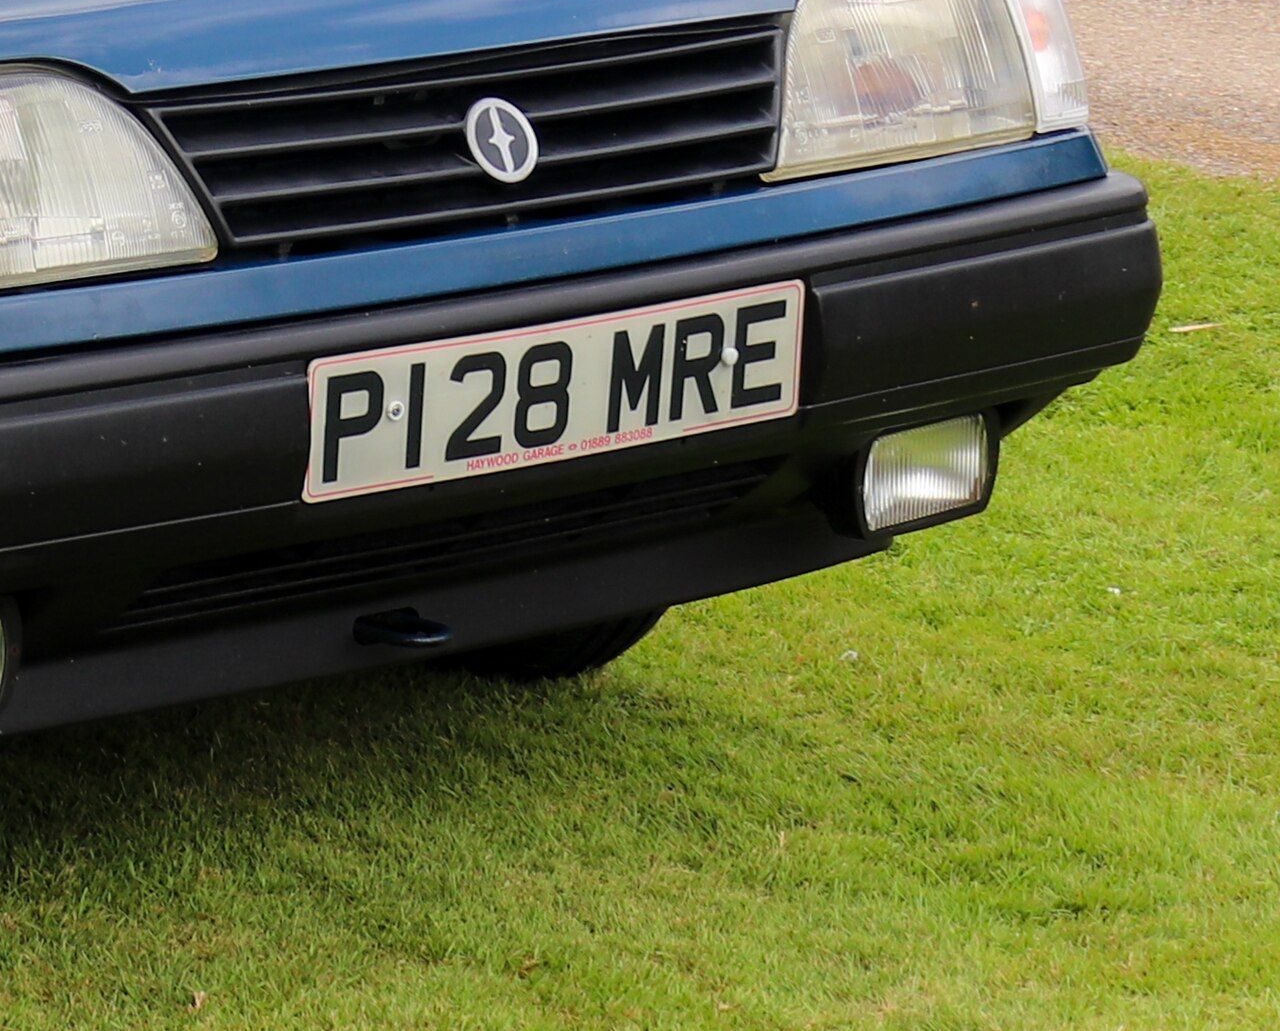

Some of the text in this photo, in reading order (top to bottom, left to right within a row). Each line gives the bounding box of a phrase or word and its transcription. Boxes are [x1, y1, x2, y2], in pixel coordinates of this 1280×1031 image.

[322, 300, 787, 483] P128 MRE
[466, 452, 519, 471] HAYWOOD
[523, 445, 565, 462] GARAGE
[580, 436, 611, 452] 01889
